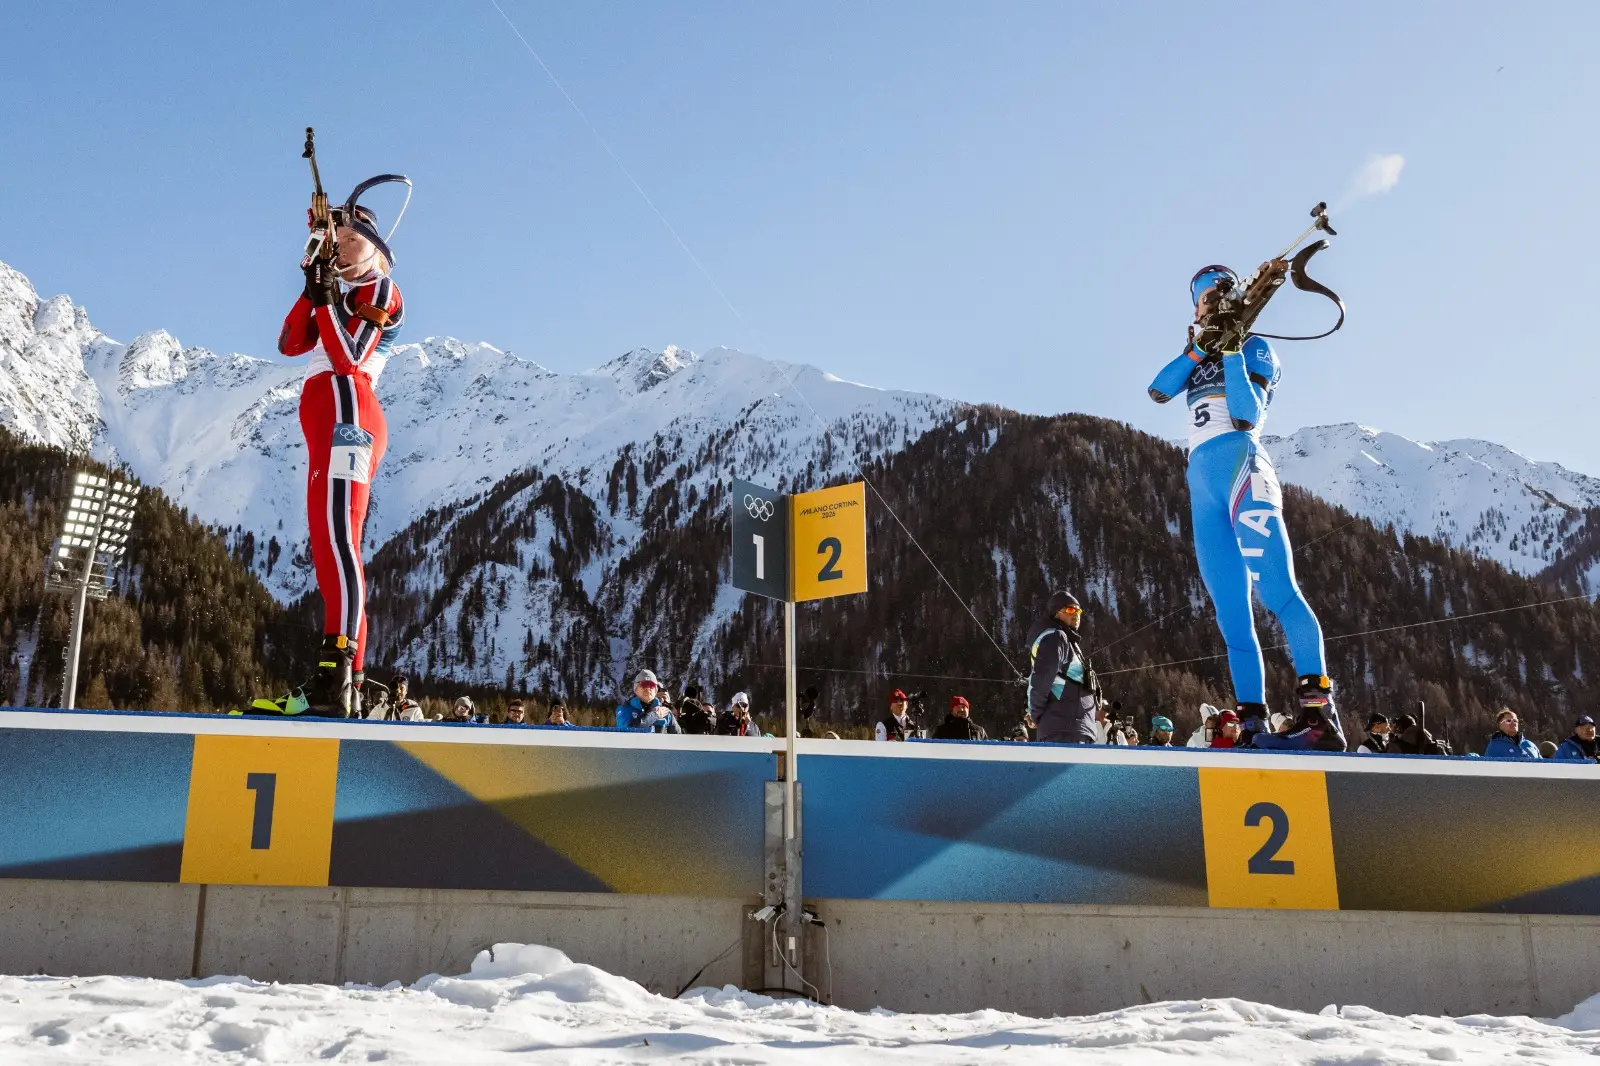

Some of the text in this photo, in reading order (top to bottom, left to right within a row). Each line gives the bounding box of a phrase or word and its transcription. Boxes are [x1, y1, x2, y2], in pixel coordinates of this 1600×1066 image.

[1194, 403, 1211, 428] 5
[348, 452, 355, 470] 1
[799, 500, 859, 517] MILANO CORTINA
[821, 511, 836, 519] 2026
[752, 533, 765, 580] 1
[817, 536, 843, 582] 2
[246, 772, 277, 850] 1
[1244, 801, 1295, 875] 2
